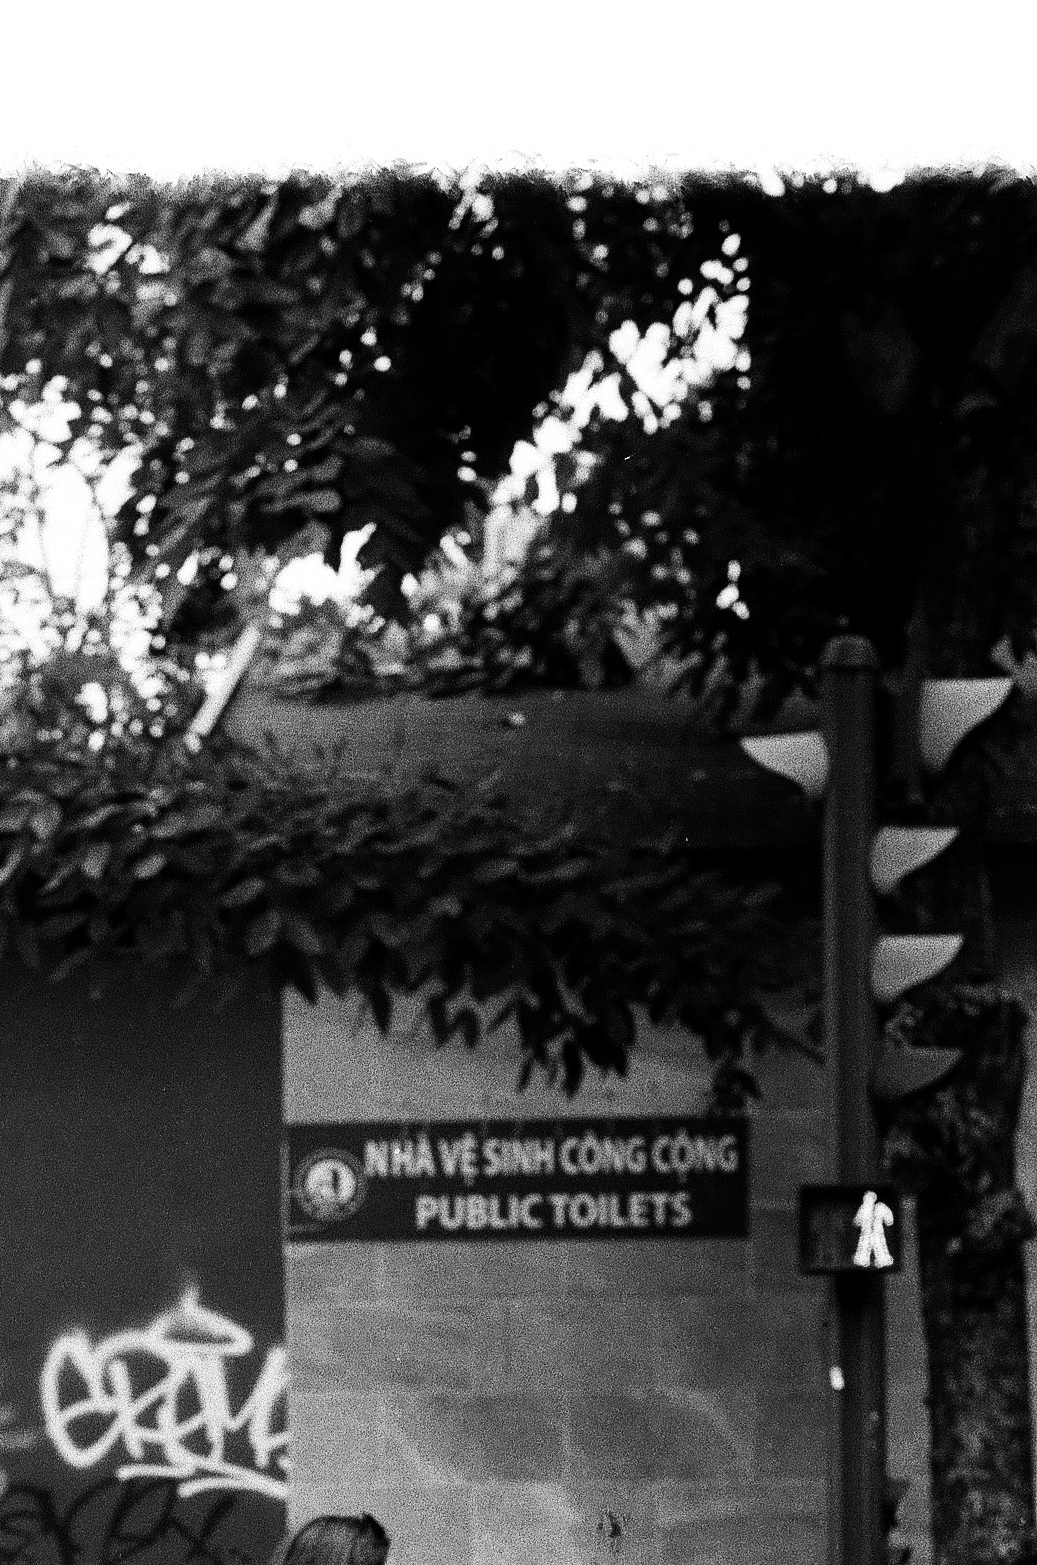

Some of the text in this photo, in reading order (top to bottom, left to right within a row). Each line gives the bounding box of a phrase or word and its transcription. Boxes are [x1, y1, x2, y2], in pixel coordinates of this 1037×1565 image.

[437, 1130, 477, 1186] VỆ
[482, 1136, 556, 1176] SINH
[561, 1130, 647, 1175] CÔNG
[652, 1129, 738, 1184] CỘNG
[416, 1192, 692, 1230] PUBLIC TOILETS
